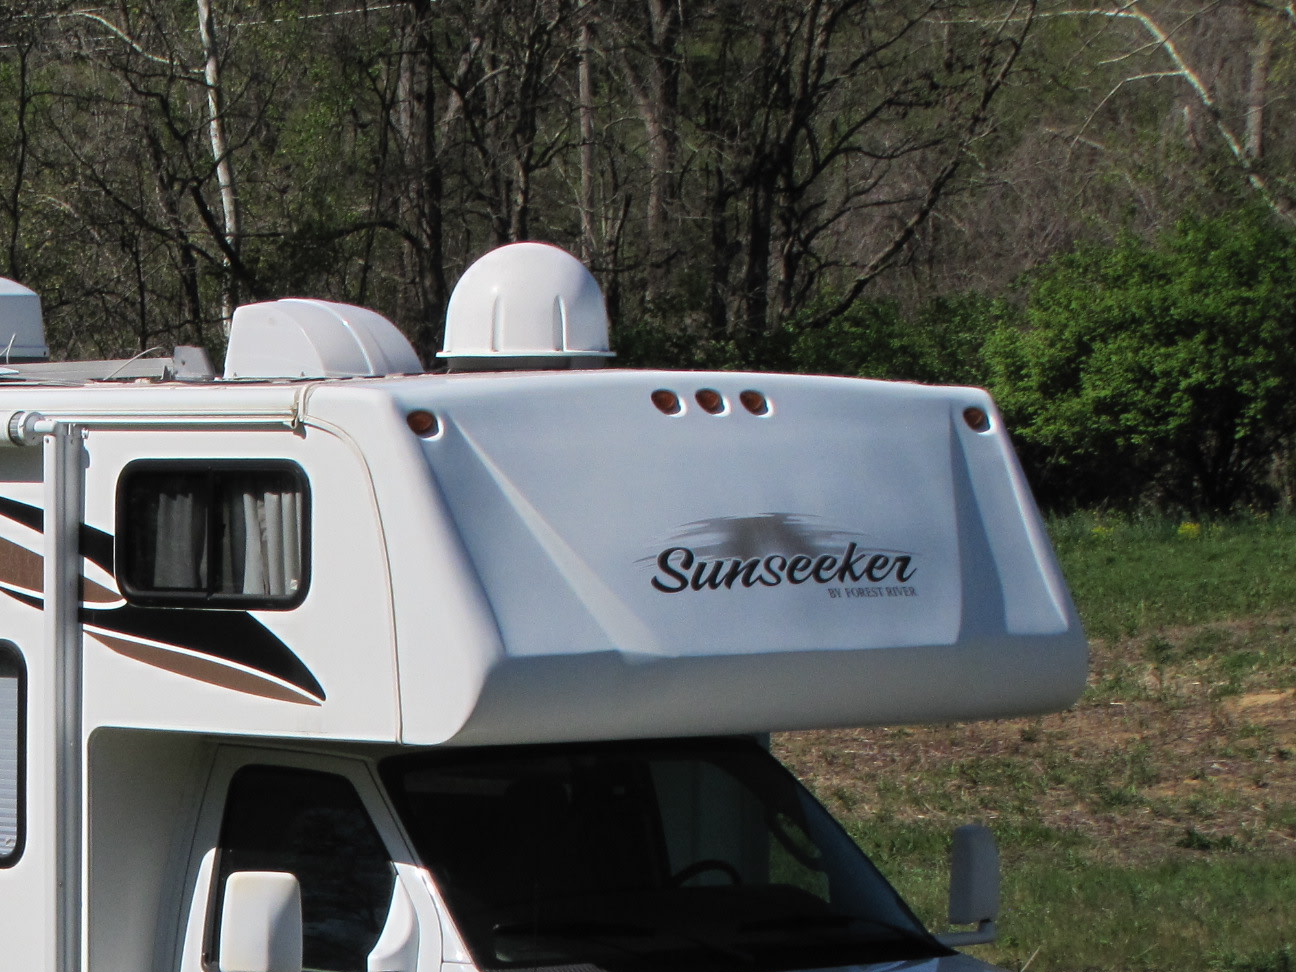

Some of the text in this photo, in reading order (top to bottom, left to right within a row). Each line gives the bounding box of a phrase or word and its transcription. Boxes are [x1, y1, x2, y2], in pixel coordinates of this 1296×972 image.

[650, 542, 917, 593] Sunseeker
[827, 585, 917, 598] BY FOREST RIVER
